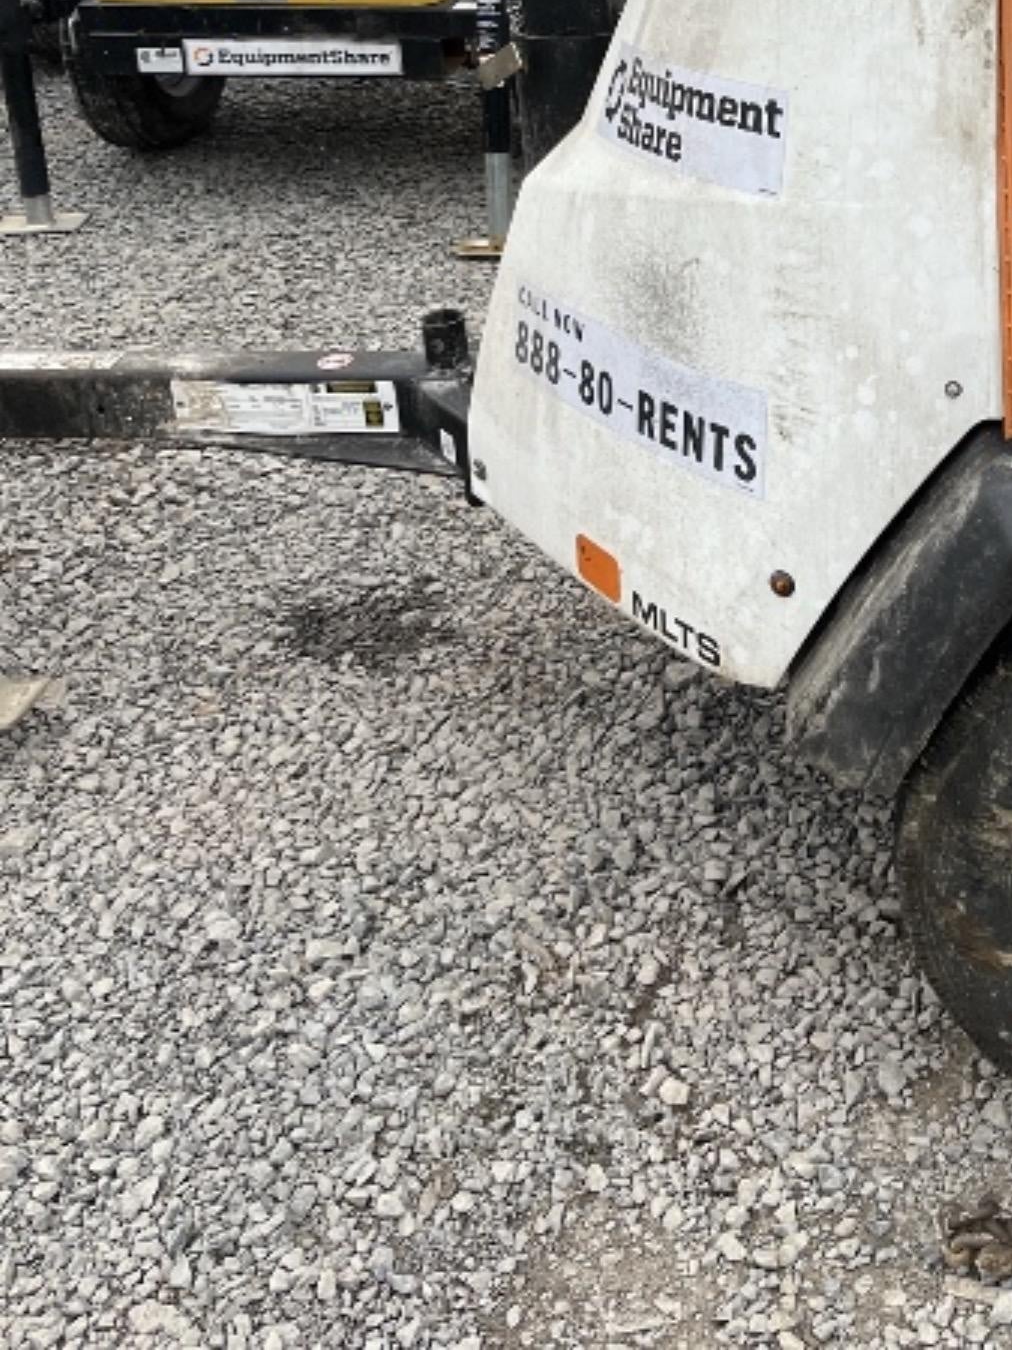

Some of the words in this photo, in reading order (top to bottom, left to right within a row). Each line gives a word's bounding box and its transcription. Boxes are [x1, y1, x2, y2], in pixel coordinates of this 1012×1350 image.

[217, 48, 392, 67] EquipmentShare
[617, 102, 683, 163] Share
[627, 57, 784, 139] Equipment
[514, 320, 758, 483] 888-80-RENTS
[631, 590, 721, 667] MLTS
